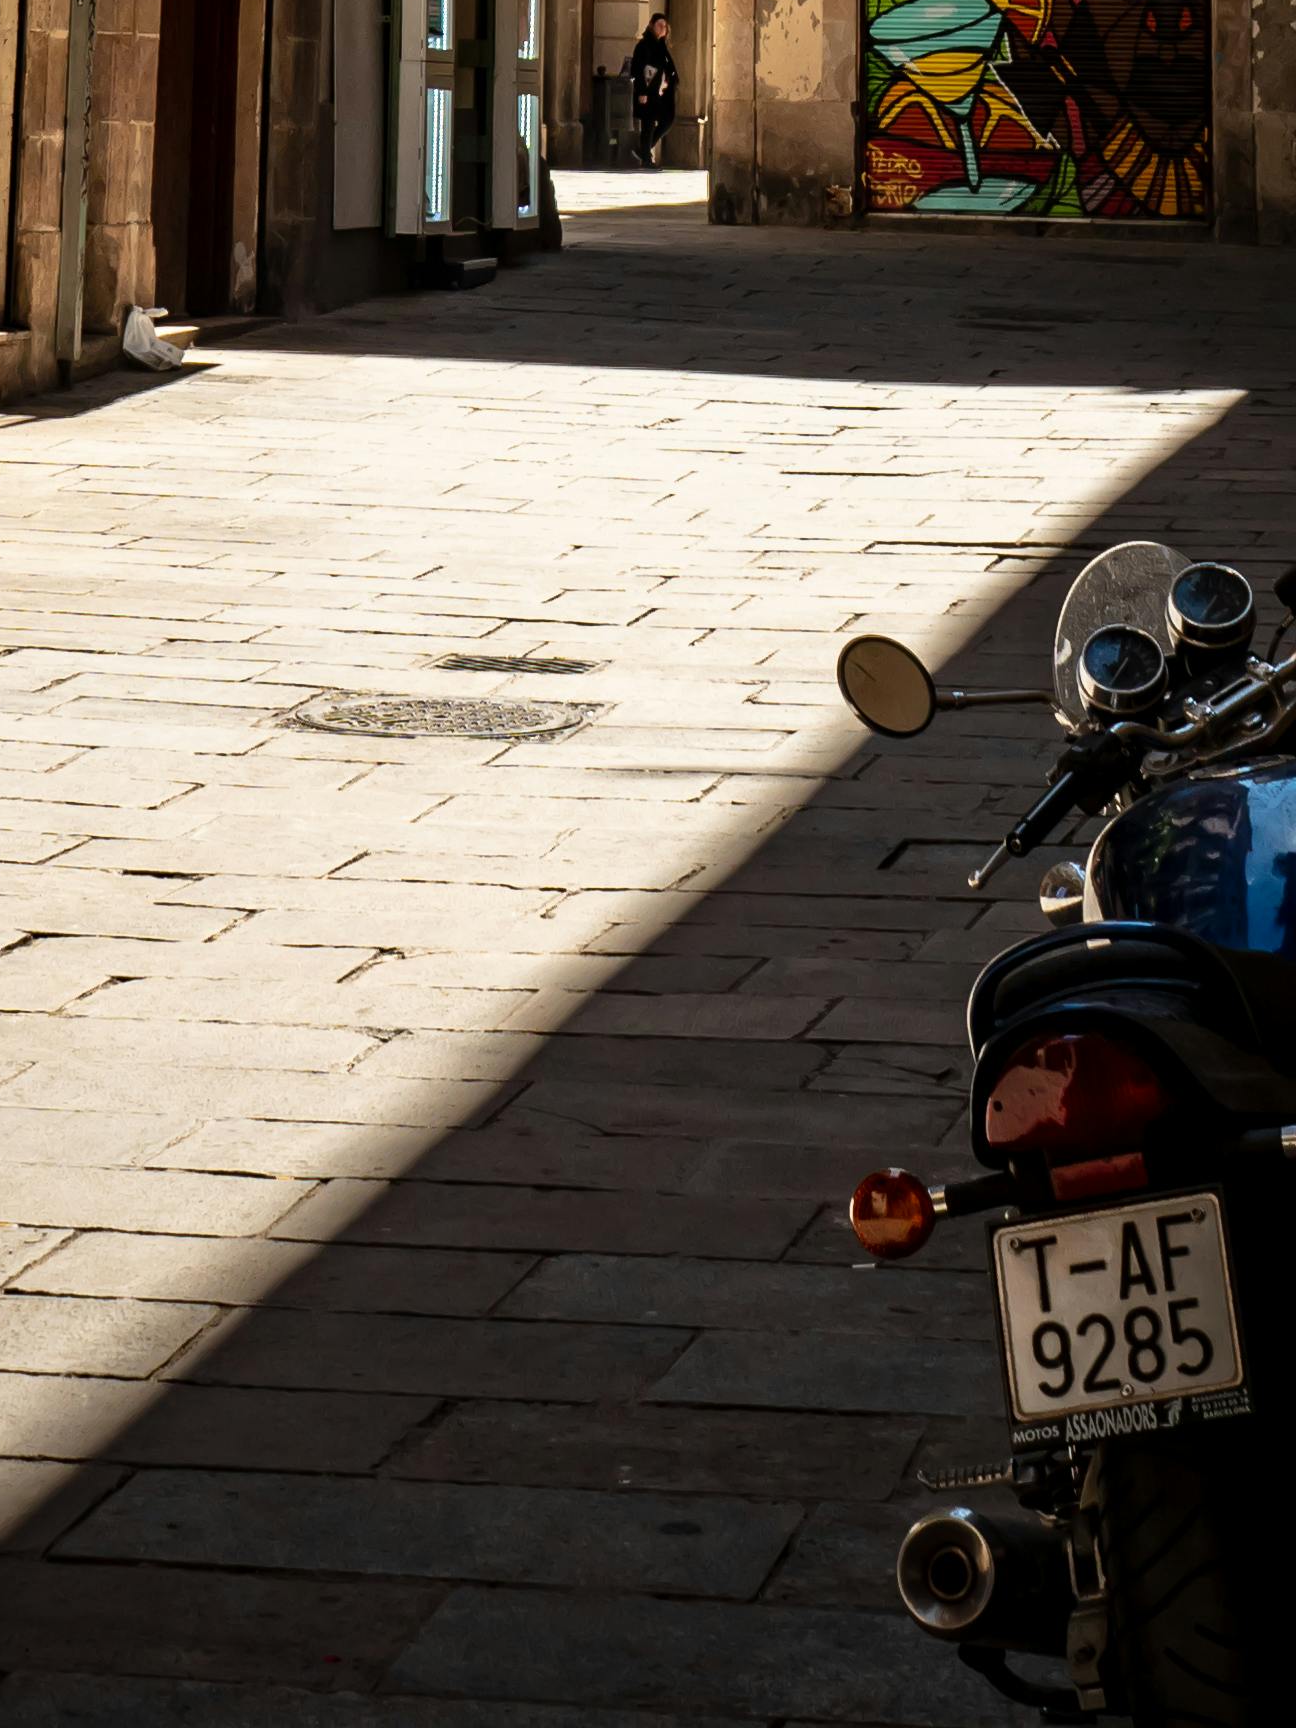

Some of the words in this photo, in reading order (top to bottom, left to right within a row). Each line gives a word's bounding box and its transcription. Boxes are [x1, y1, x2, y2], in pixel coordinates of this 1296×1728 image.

[1010, 1213, 1205, 1311] T-AF
[1033, 1298, 1213, 1397] 9285
[1013, 1425, 1060, 1444] MOTOS
[1065, 1403, 1157, 1442] ASSAONADORS
